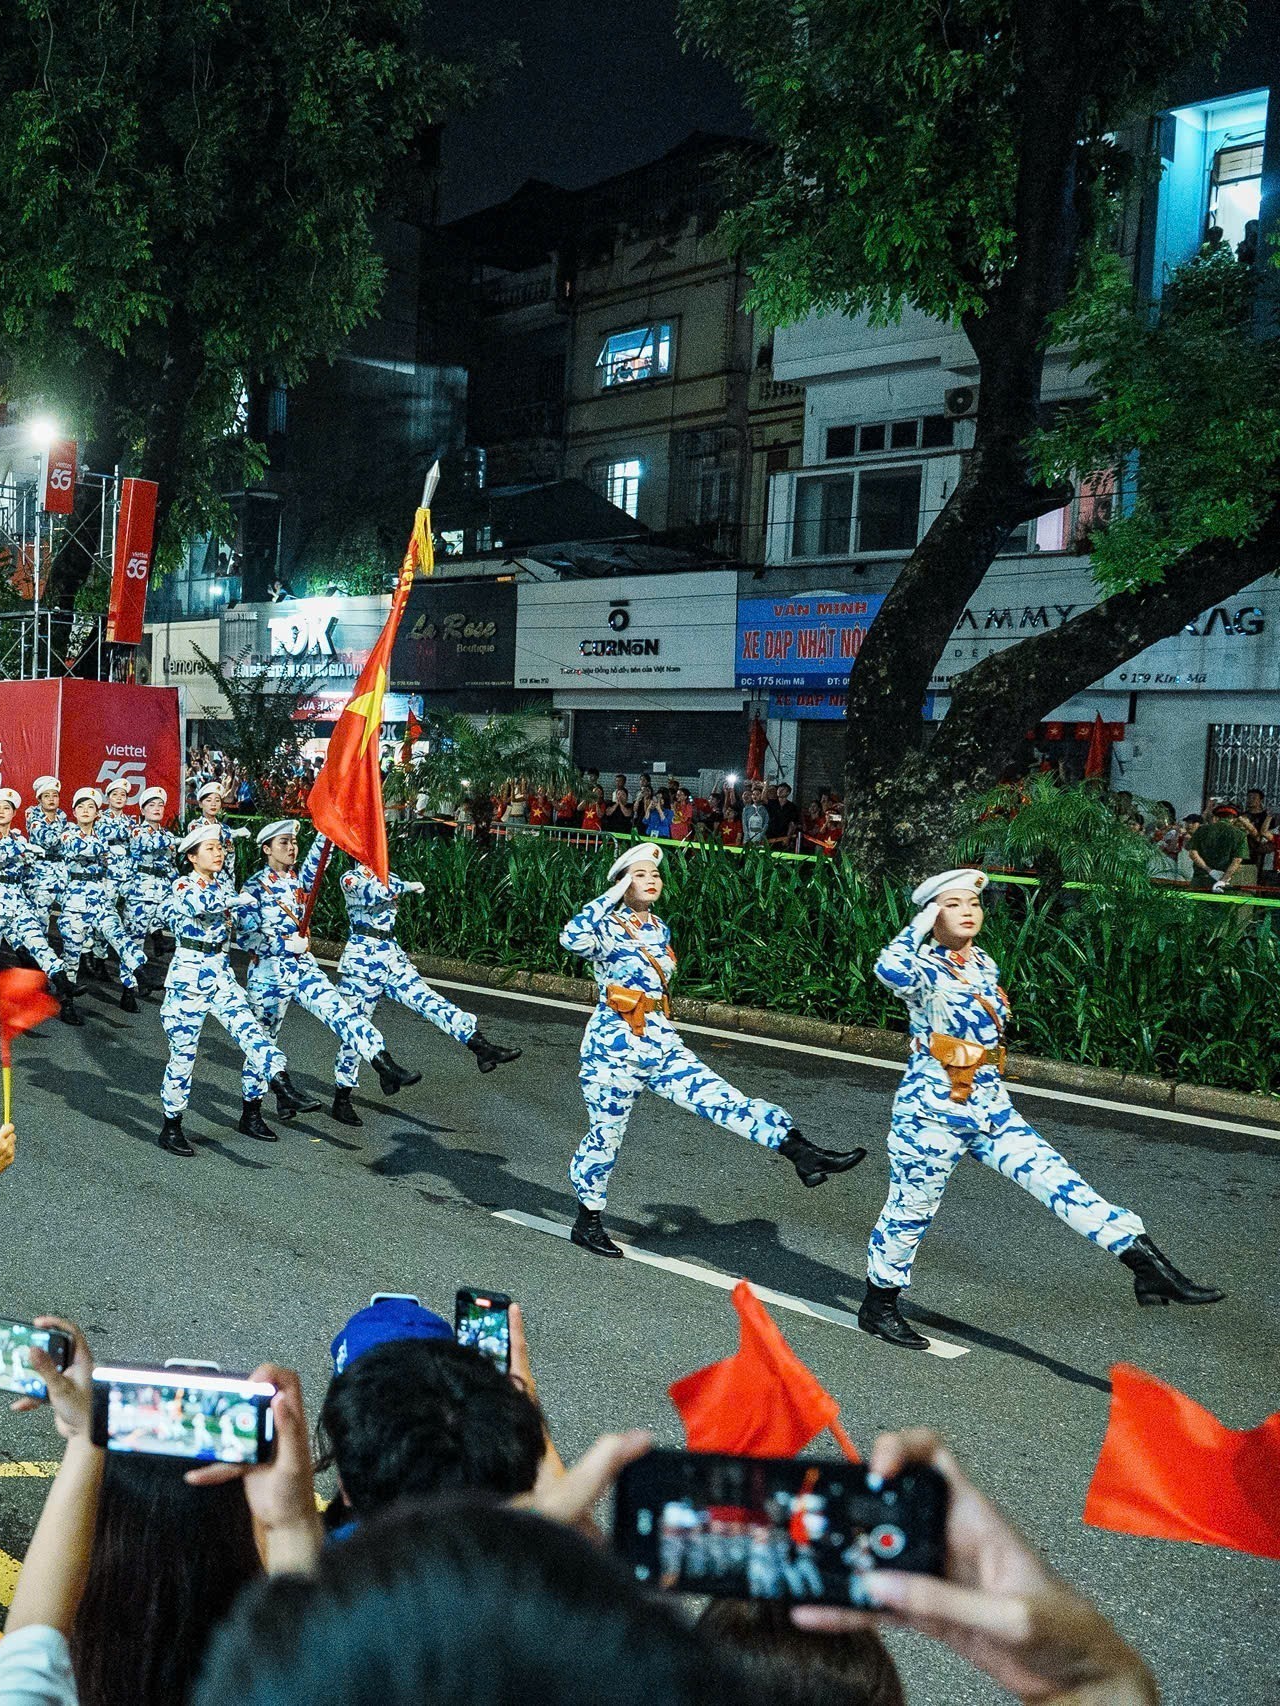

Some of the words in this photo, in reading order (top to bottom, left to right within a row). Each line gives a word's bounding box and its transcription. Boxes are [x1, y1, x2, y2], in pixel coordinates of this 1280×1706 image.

[50, 468, 71, 491] 5G
[126, 558, 148, 580] 5G
[817, 602, 867, 615] MINH
[442, 613, 497, 640] Rose
[456, 643, 495, 655] Boutique
[742, 630, 760, 659] XE
[764, 628, 793, 666] ĐẠP
[797, 621, 837, 665] NHẬT
[328, 663, 345, 678] GIA
[758, 677, 774, 686] 175
[105, 744, 147, 758] viettel
[95, 760, 147, 806] 5G
